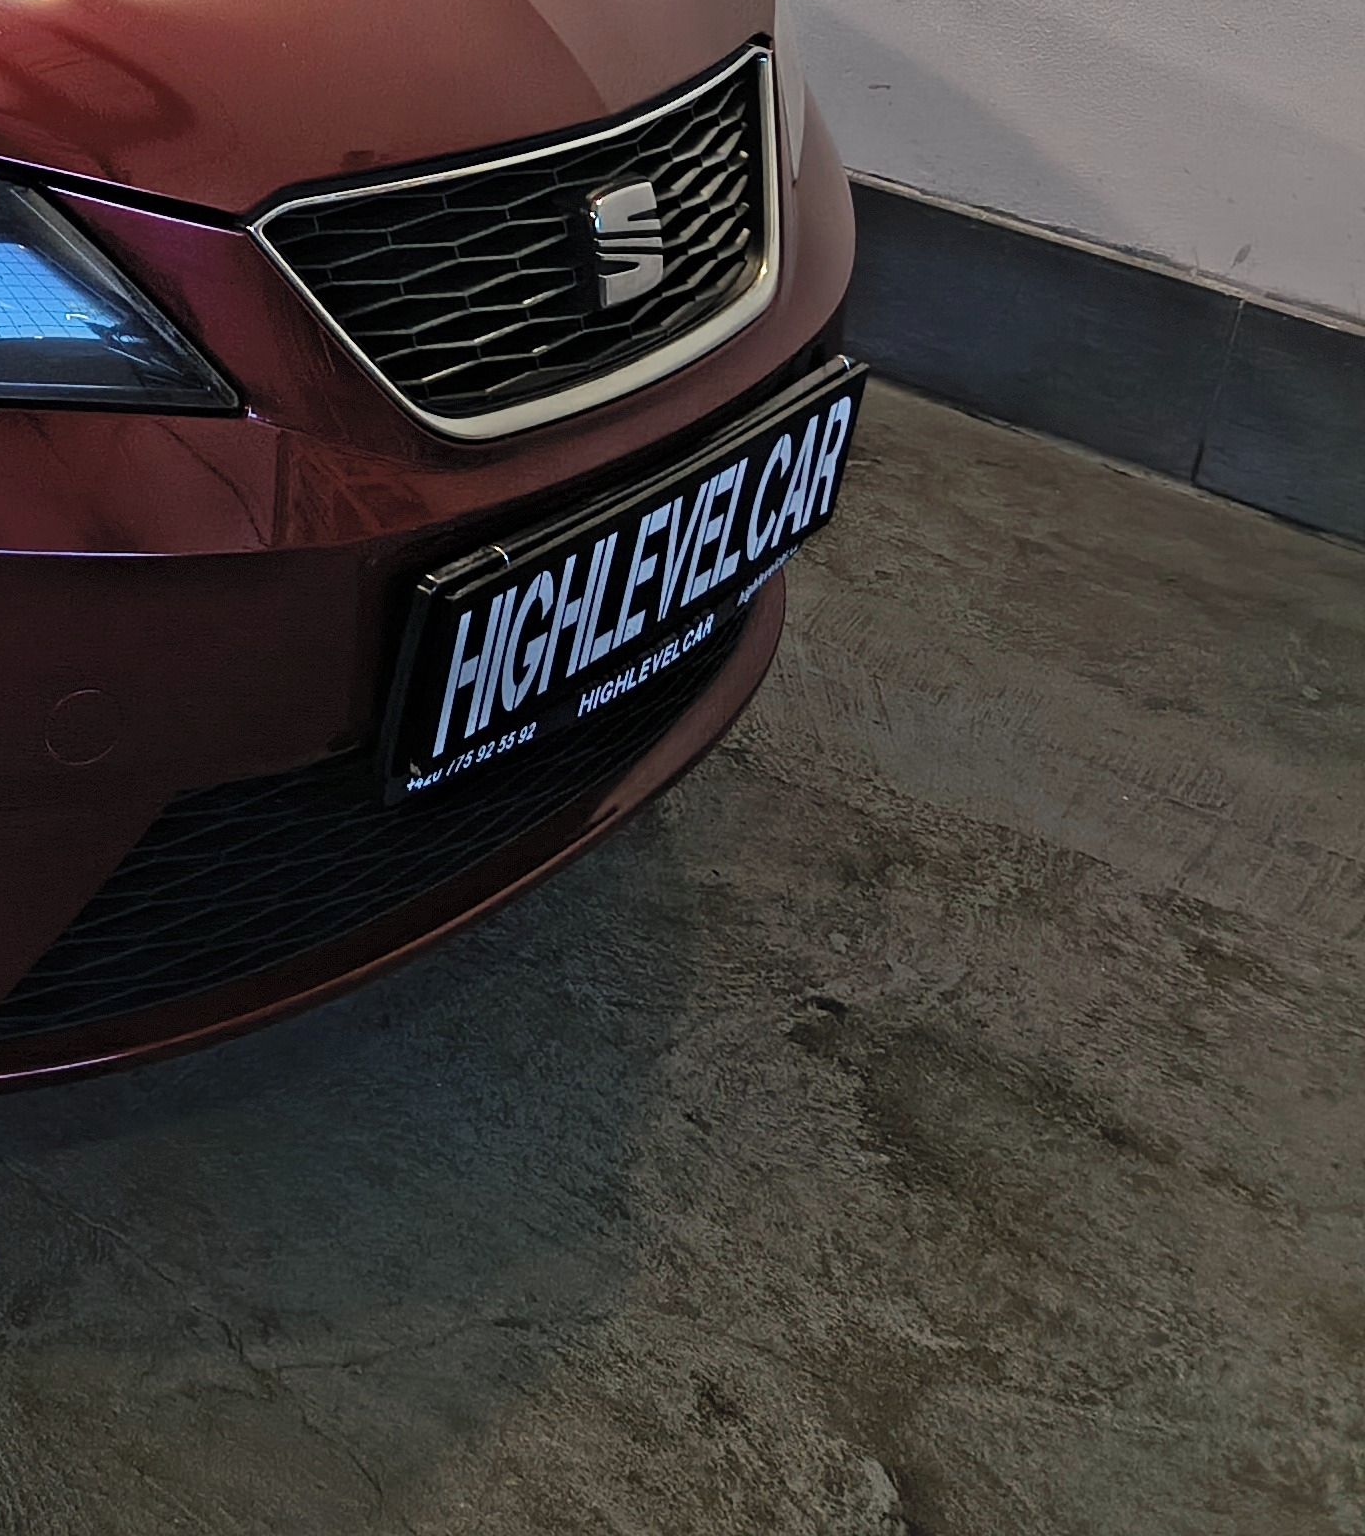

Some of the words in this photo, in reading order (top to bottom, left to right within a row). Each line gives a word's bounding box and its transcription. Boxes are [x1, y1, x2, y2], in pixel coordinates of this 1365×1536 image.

[432, 457, 748, 758] HIGHLEVEL
[746, 395, 853, 562] CAR
[577, 638, 681, 719] HIGHLEVEL
[681, 613, 716, 653] CAR
[475, 740, 496, 763] 92
[496, 730, 517, 754] 55
[517, 721, 538, 745] 92
